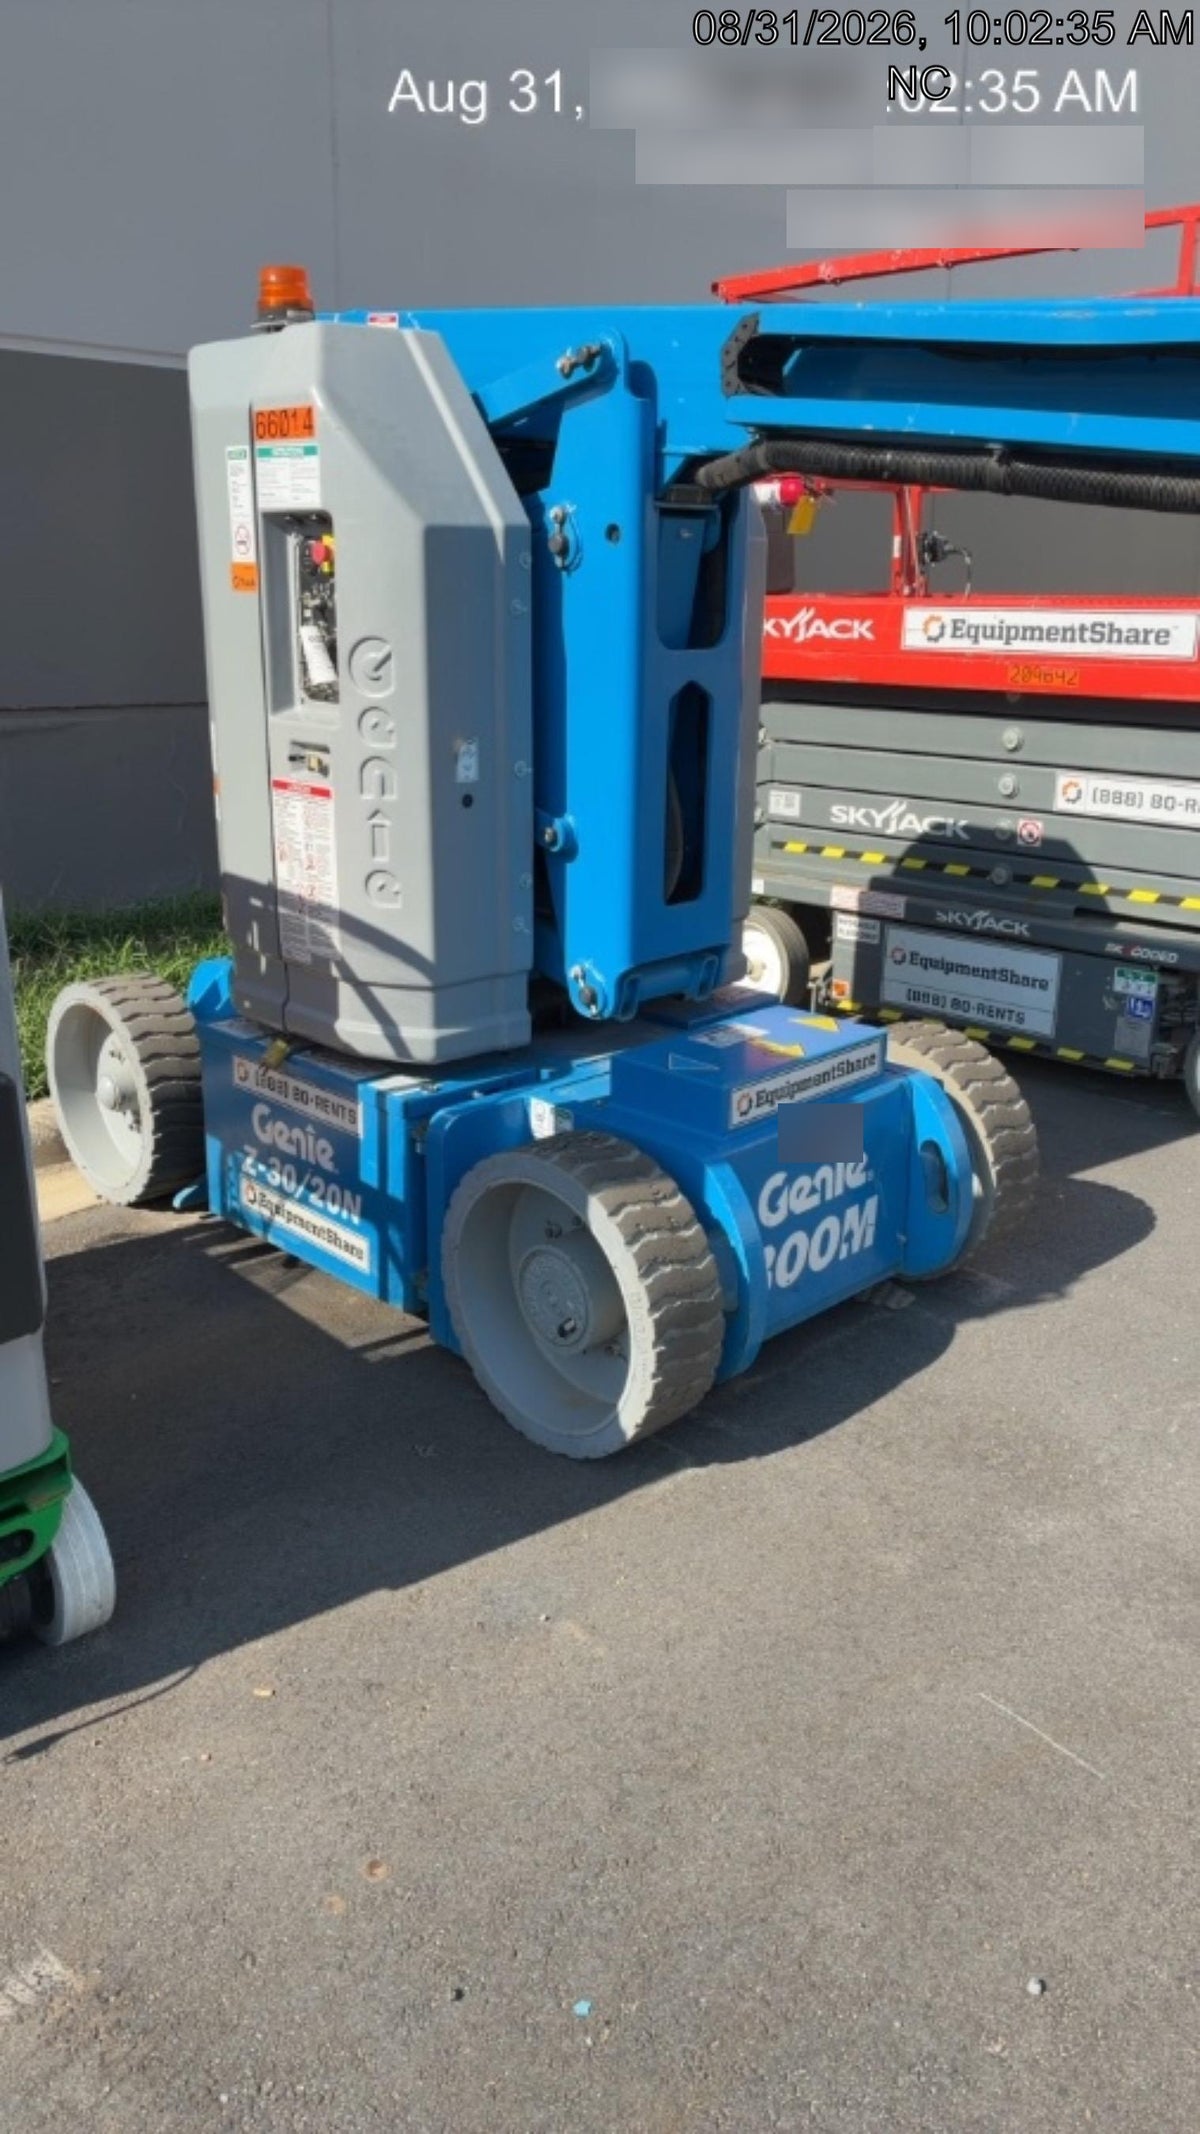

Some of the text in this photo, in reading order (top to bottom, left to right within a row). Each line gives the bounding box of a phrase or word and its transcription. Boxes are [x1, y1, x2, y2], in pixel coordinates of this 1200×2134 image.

[256, 406, 314, 439] 66014
[763, 606, 876, 643] KYJACK
[949, 617, 1171, 647] EquipmentShare
[829, 799, 971, 841] SKYJACK
[1092, 786, 1200, 815] (888) 80-R
[935, 909, 1031, 938] SKYJACK
[908, 950, 1050, 992] EquipmentShare
[950, 997, 1026, 1026] 80-RENTS
[753, 1051, 877, 1109] EquipmentShare
[252, 1102, 336, 1173] Genie
[241, 1144, 363, 1226] Z-30/20N
[757, 1152, 869, 1228] Genie
[258, 1193, 364, 1262] EquipmentShare
